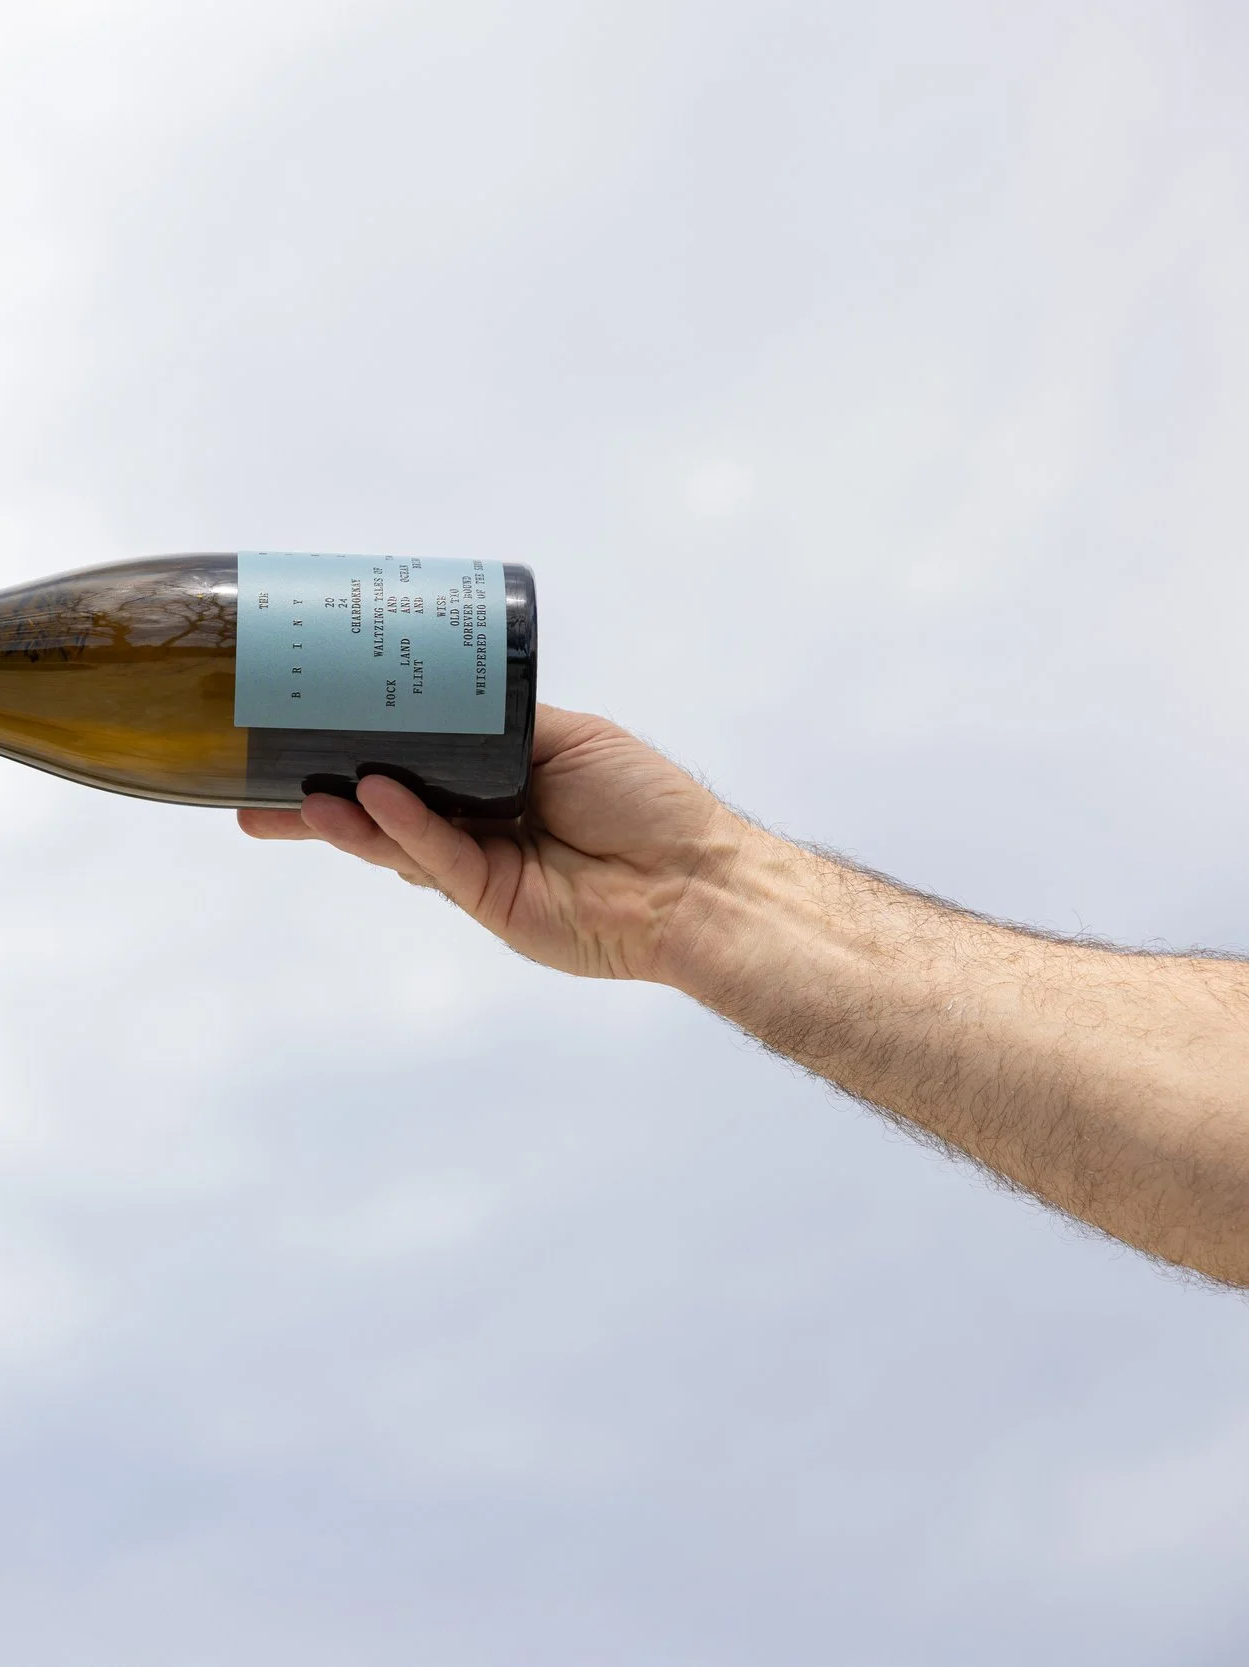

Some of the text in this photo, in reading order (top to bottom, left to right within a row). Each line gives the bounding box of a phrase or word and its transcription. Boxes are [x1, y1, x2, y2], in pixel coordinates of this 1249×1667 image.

[474, 573, 486, 585] THE
[258, 593, 269, 610] THE
[324, 597, 335, 609] 20
[337, 597, 348, 609] 24
[400, 596, 411, 614] AND
[413, 596, 424, 614] AND
[475, 588, 486, 600] OF
[350, 578, 362, 634] CHARDONNAY
[372, 566, 384, 658] WALTZING TALES OF
[436, 595, 447, 618] WISE
[449, 608, 460, 627] OLD
[461, 575, 474, 647] FOREVER BOUND
[475, 604, 487, 628] ECHO
[385, 596, 398, 708] ROCK AND
[400, 638, 411, 666] LAND
[475, 633, 487, 696] WHISPERED
[412, 659, 424, 695] FLINT
